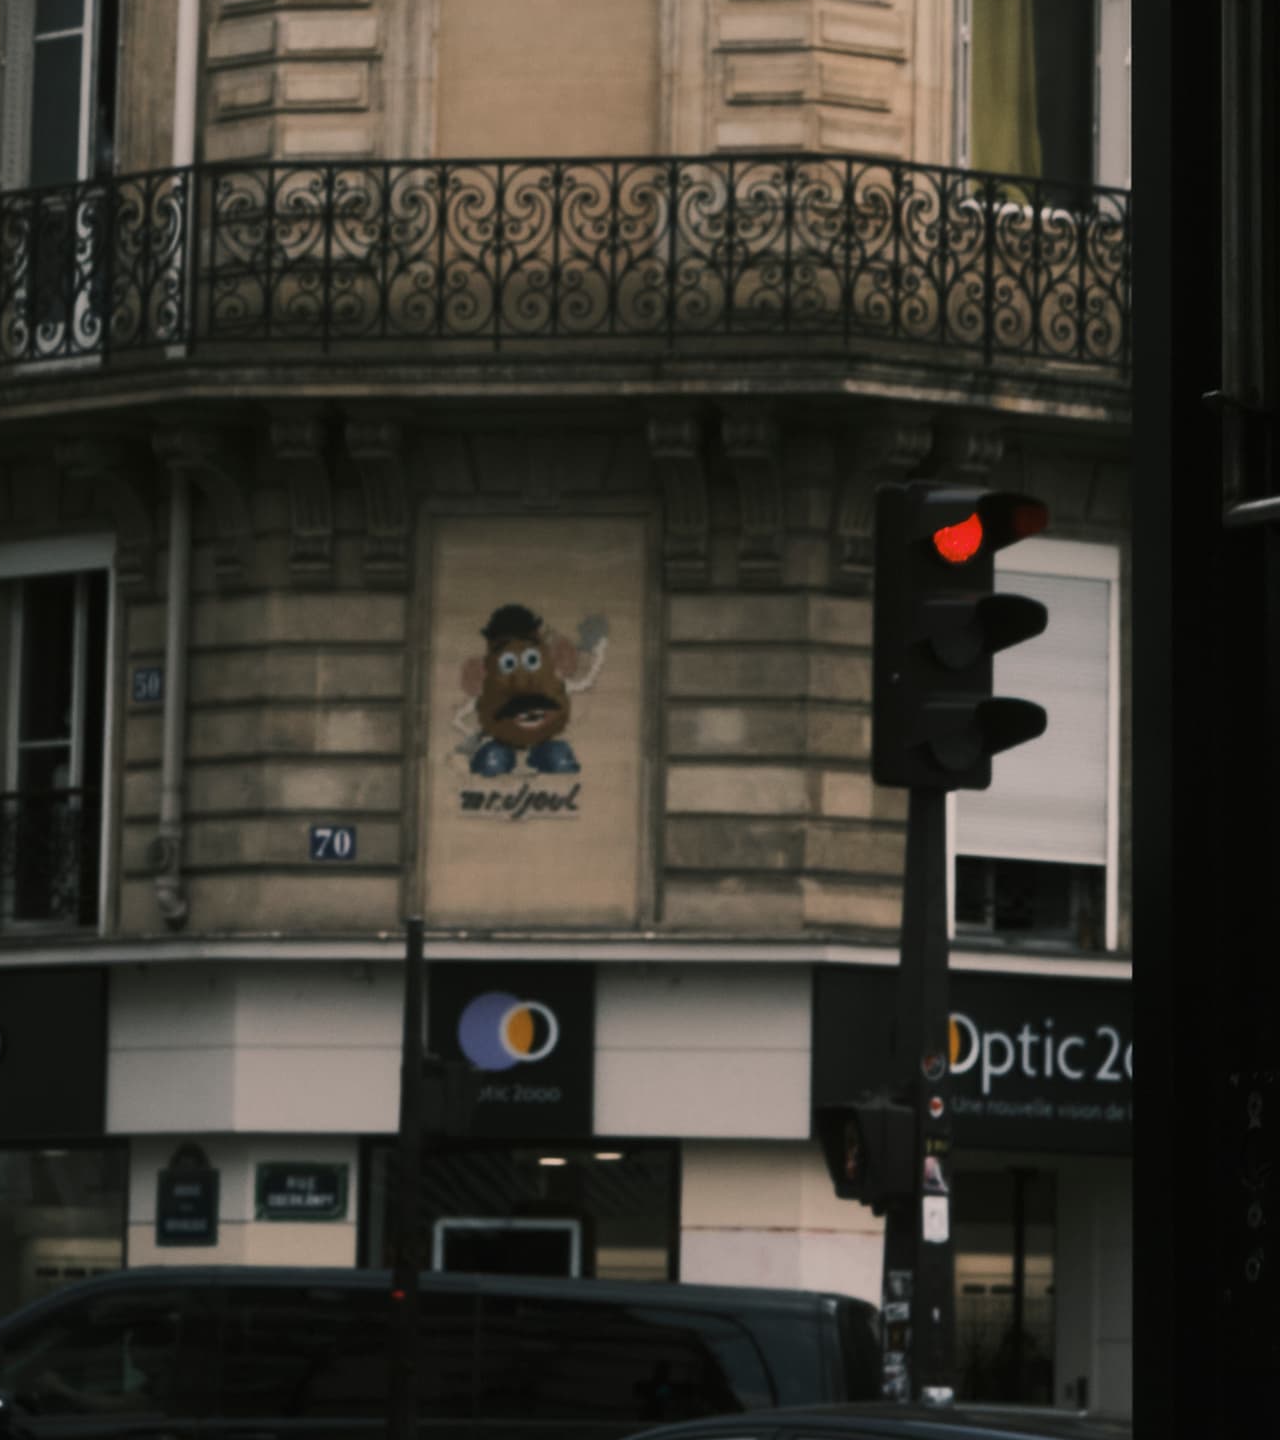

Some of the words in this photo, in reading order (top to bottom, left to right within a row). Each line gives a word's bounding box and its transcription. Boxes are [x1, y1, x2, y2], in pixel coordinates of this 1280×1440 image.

[134, 672, 162, 697] 50
[314, 830, 352, 857] 70
[948, 1011, 1088, 1095] Optic
